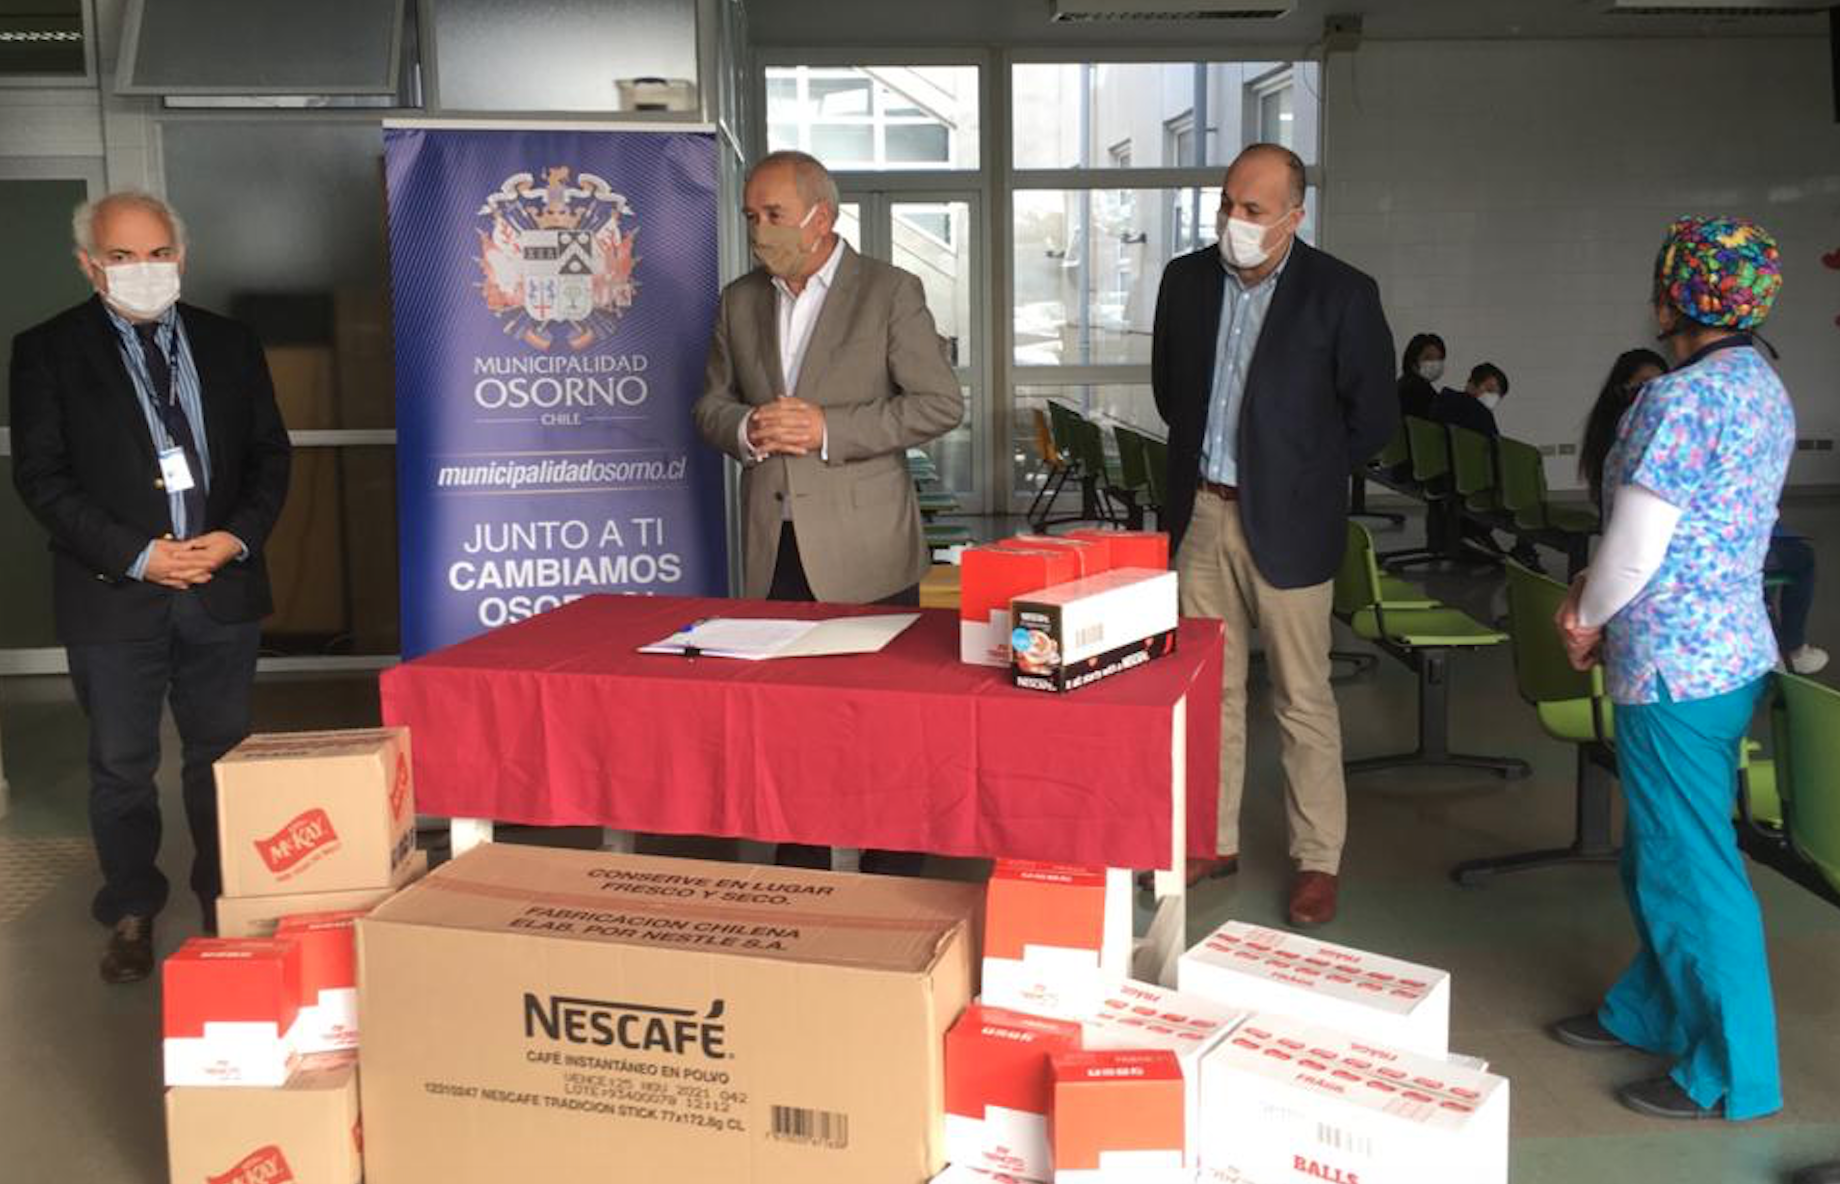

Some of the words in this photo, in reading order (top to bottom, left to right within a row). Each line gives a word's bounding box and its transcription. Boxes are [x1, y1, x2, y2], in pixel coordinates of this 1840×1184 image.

[474, 355, 648, 375] MUNICIPALIDAD
[474, 376, 648, 408] OSORNO
[540, 413, 581, 426] CHILE
[437, 457, 687, 489] municipalidadosorno.cl
[464, 519, 589, 553] JUNTO
[600, 519, 624, 548] A
[631, 517, 663, 546] TI
[448, 553, 682, 591] CAMBIAMOS
[586, 868, 706, 888] CONSERVE
[714, 877, 748, 890] EN
[752, 881, 836, 897] LUGAR
[600, 881, 695, 898] FRESCO
[701, 890, 720, 900] Y
[719, 891, 793, 906] SECO.
[508, 917, 575, 932] ELAB.
[582, 924, 638, 939] POR
[641, 930, 736, 949] NESTLE
[740, 938, 790, 951] S.A.
[524, 906, 690, 931] FABRICACION
[693, 921, 802, 939] CHILENA
[523, 992, 726, 1060] NESCAFÉ
[526, 1050, 562, 1066] CAFÉ
[564, 1054, 659, 1077] INSTANTÁNEO
[661, 1065, 680, 1079] EN
[683, 1068, 731, 1085] POLVO
[543, 1096, 615, 1116] TRADICION
[617, 1104, 659, 1121] STICK
[726, 1116, 747, 1132] CL
[1292, 1154, 1361, 1184] BALLS
